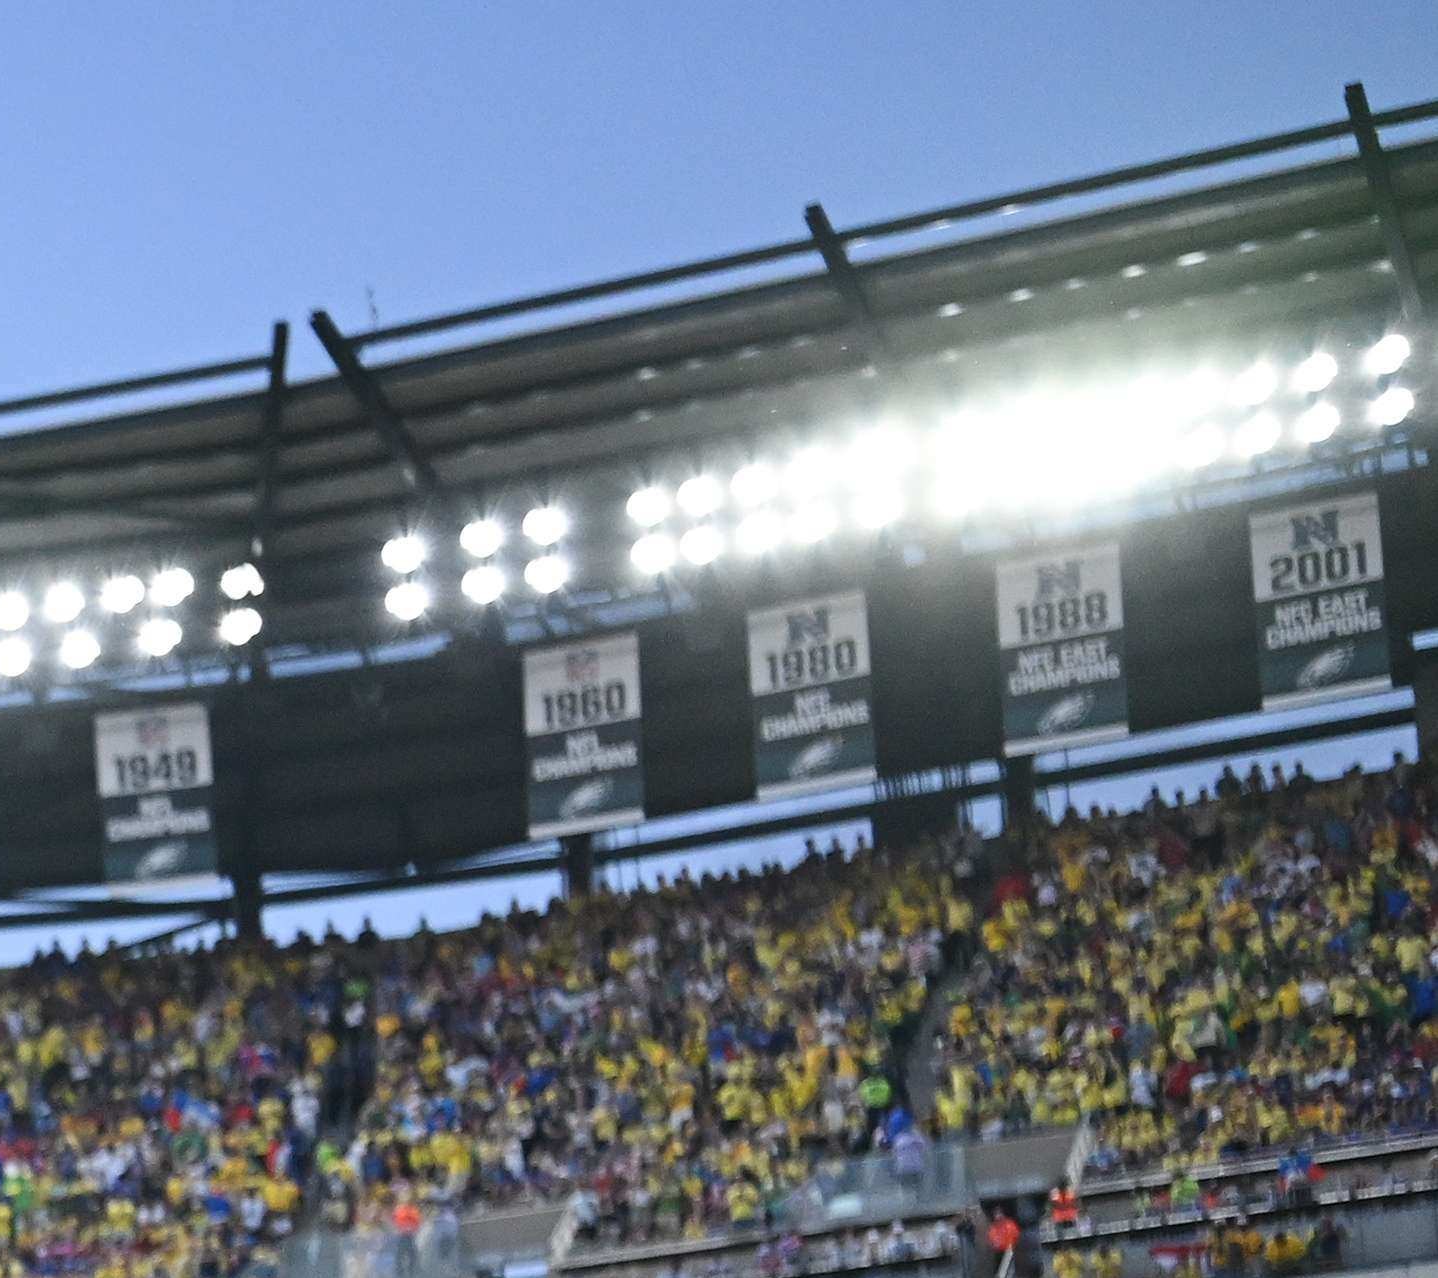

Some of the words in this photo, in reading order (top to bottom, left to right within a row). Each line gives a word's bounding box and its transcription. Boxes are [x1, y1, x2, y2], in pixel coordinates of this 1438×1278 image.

[1271, 543, 1367, 591] 2001
[1016, 591, 1108, 639] 1988
[1265, 606, 1382, 650] CHAMPIONS
[767, 639, 857, 688] 1980
[1008, 654, 1120, 696] CHAMPIONS
[543, 679, 626, 729] 1960
